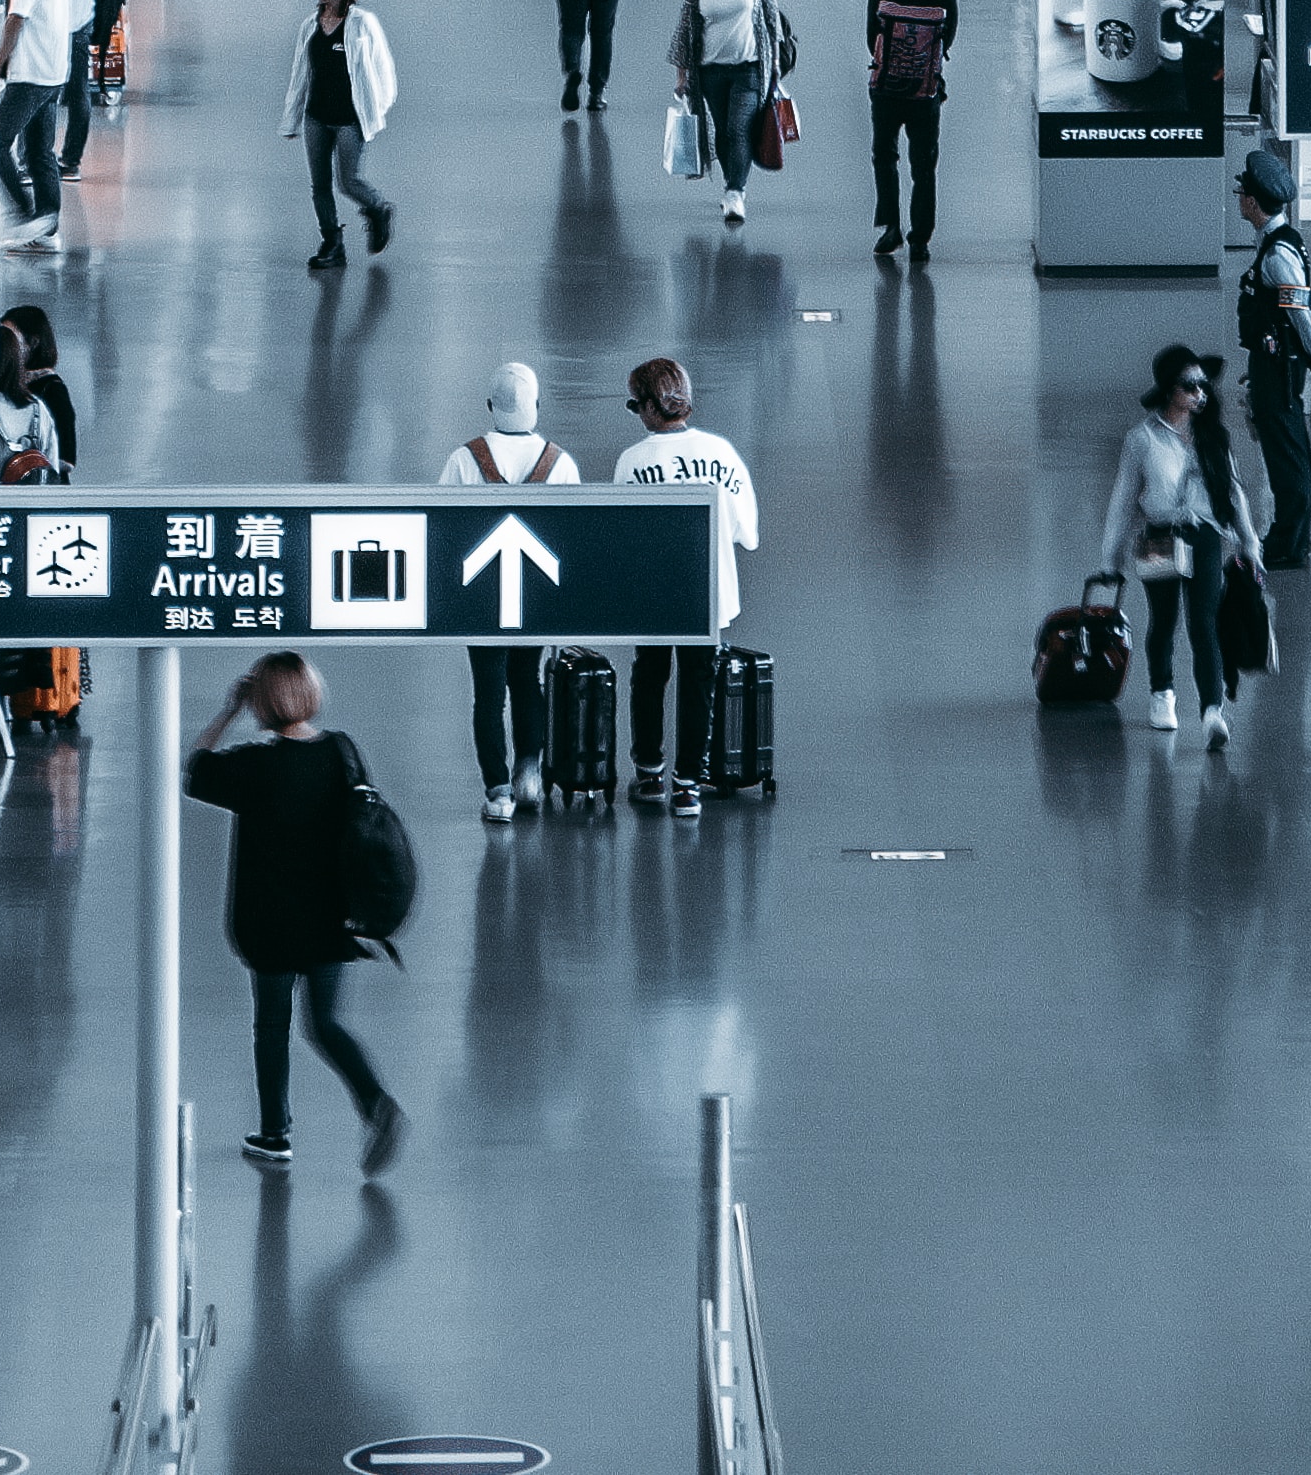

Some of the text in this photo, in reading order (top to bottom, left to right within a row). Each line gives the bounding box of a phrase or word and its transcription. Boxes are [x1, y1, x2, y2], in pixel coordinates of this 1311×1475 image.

[1060, 128, 1204, 141] STARBUCKS COFFEE
[150, 563, 285, 598] Arrivals
[164, 605, 216, 631] 到达
[232, 605, 285, 631] 도착
